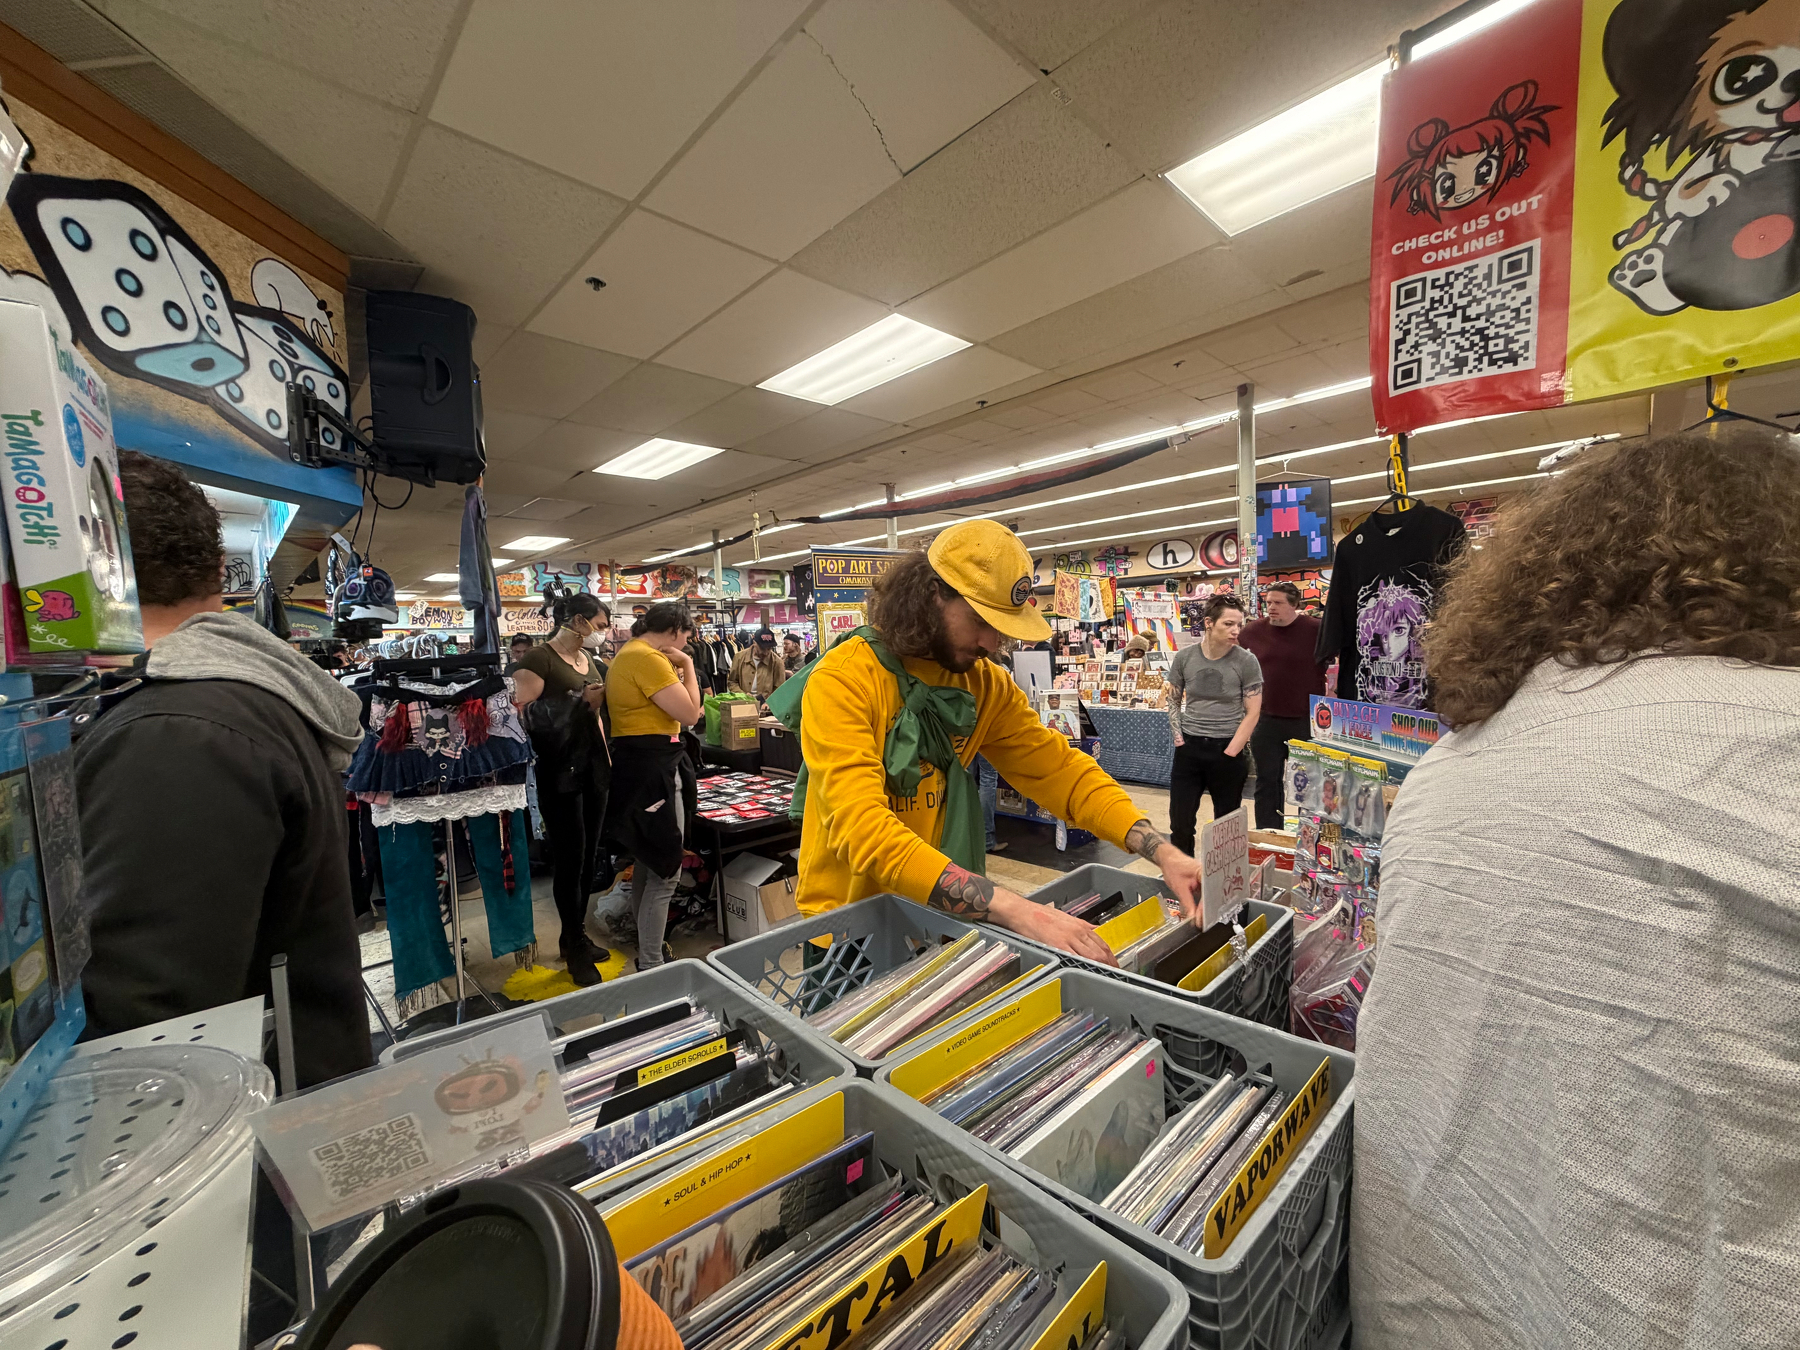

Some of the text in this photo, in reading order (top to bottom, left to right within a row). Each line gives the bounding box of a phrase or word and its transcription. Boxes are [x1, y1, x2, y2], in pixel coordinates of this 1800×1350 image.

[1391, 194, 1543, 255] CHECK US OUT
[1421, 229, 1505, 264] ONLINE!
[818, 559, 845, 573] POP
[850, 560, 873, 574] ART
[420, 607, 453, 621] EMON
[507, 624, 536, 632] LEATHER
[831, 615, 857, 629] CARL
[1333, 701, 1380, 724] BUY 2 GET
[1391, 712, 1440, 741] SHOP OUR
[1348, 721, 1373, 740] FREE
[951, 1008, 1017, 1051] VIDEO GAME SOUNDTRACKS
[649, 1045, 718, 1078] THE ELDER SCROLLS
[1213, 1063, 1330, 1240] VAPORWAVE
[673, 1156, 743, 1202] SOUL & HIP HOP
